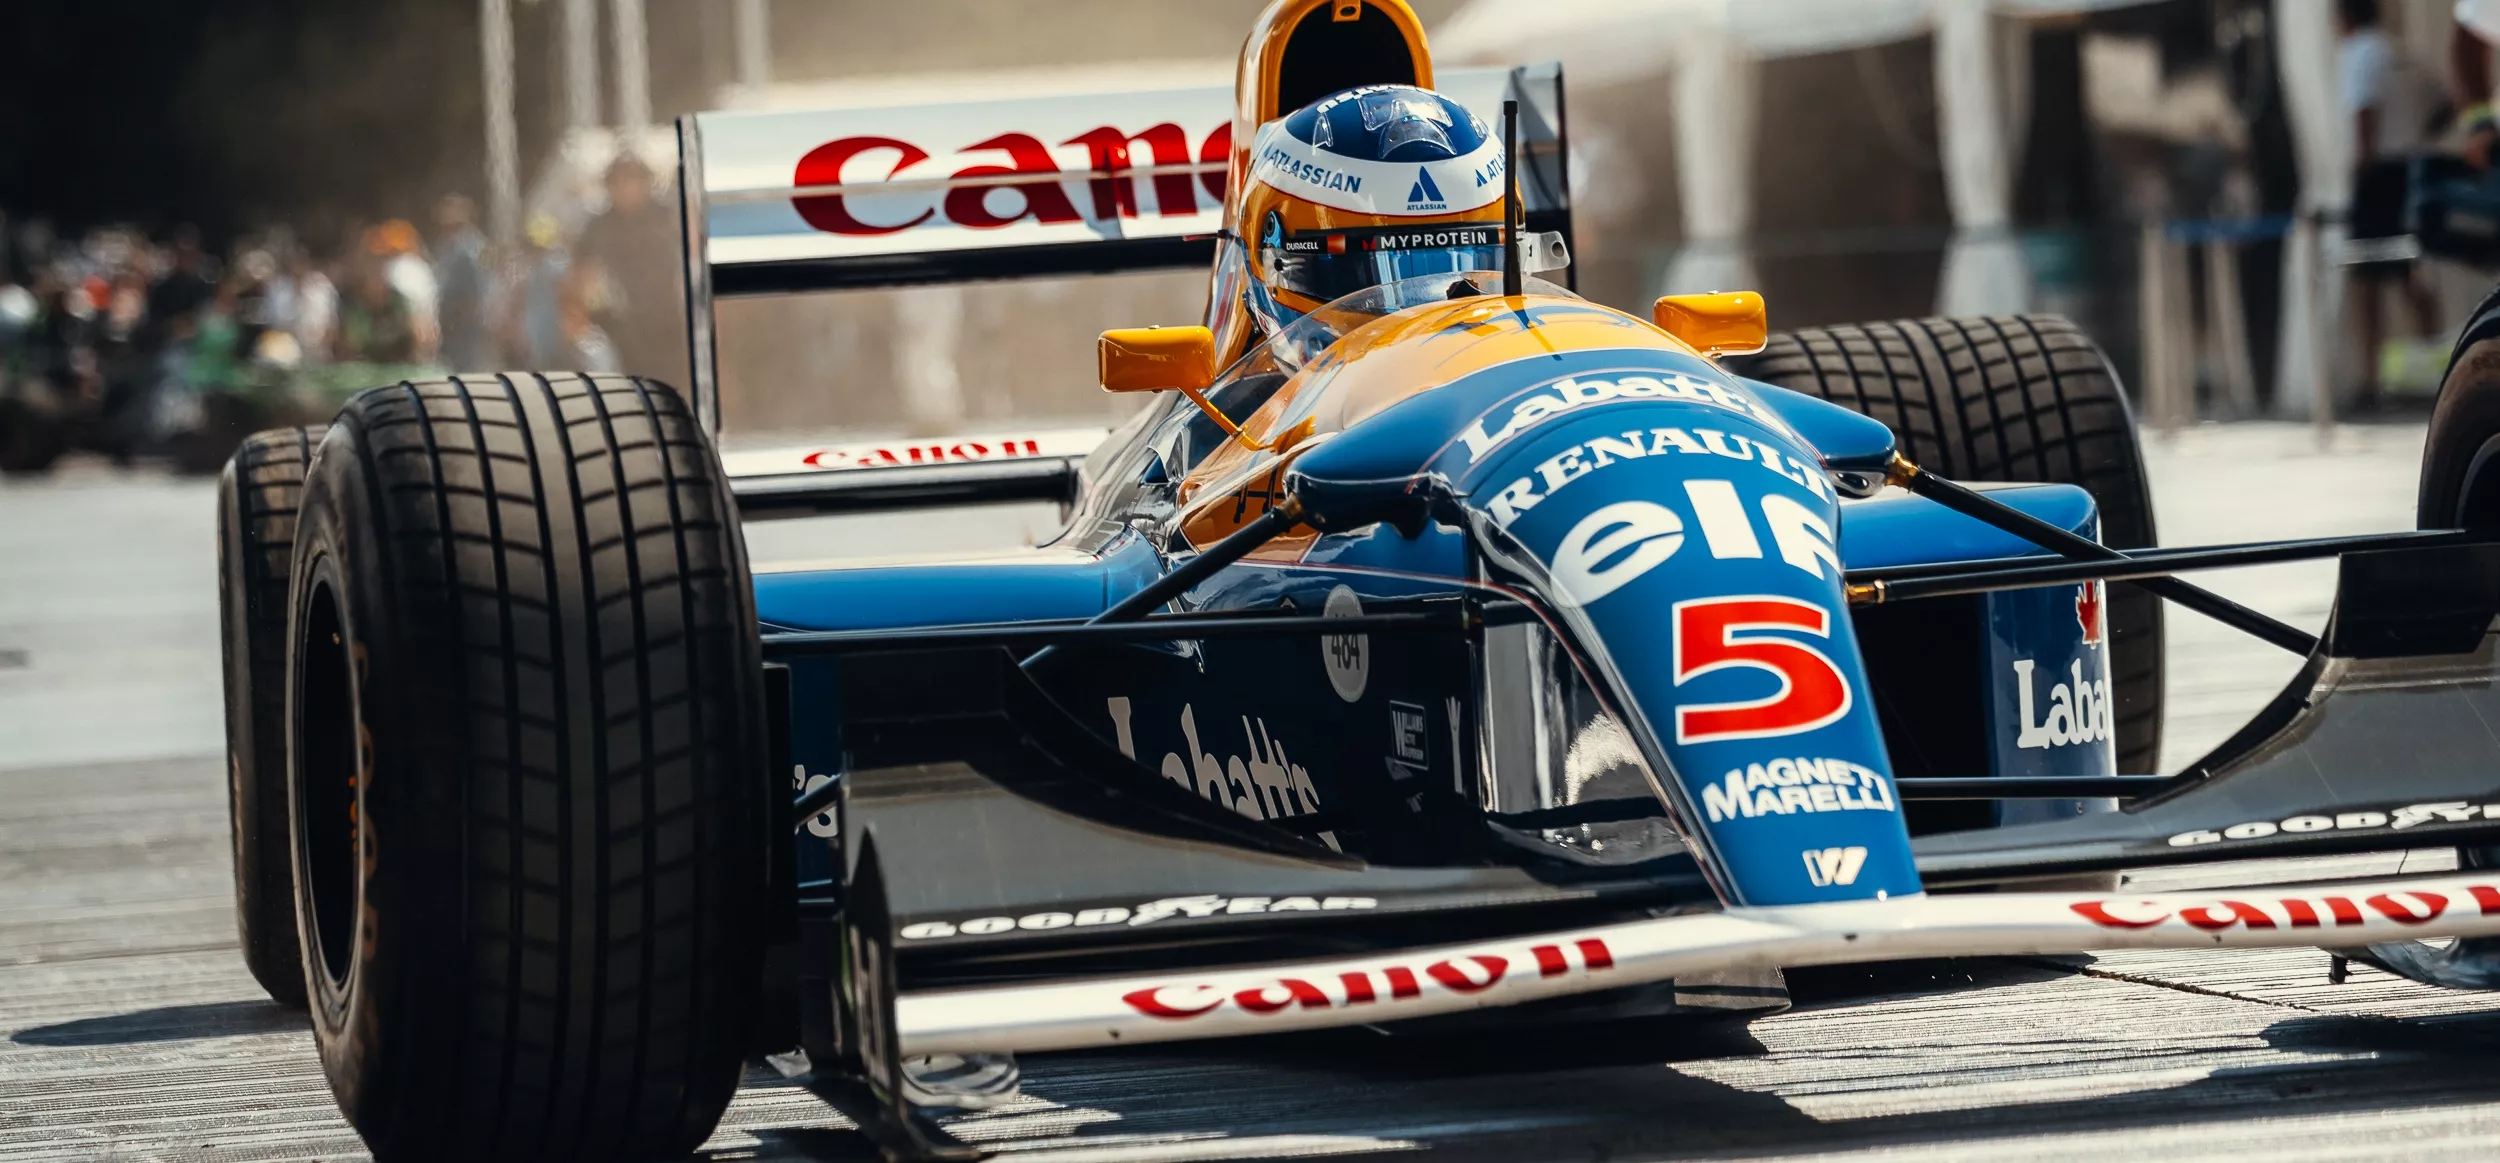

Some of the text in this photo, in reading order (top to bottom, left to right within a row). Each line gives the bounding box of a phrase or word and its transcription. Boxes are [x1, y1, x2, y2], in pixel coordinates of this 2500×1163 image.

[1268, 149, 1362, 193] ATLASSIAN
[1407, 203, 1447, 211] ATLASSIAN
[1286, 241, 1319, 251] DURACELL
[1380, 231, 1488, 250] MYPROTEIN
[802, 439, 1041, 469] Canon
[1484, 427, 1832, 534] RENAULT
[1331, 613, 1360, 670] 484
[1672, 594, 1853, 746] 5
[900, 894, 1378, 940] GOODYEAR
[1122, 937, 1615, 1021] Canon
